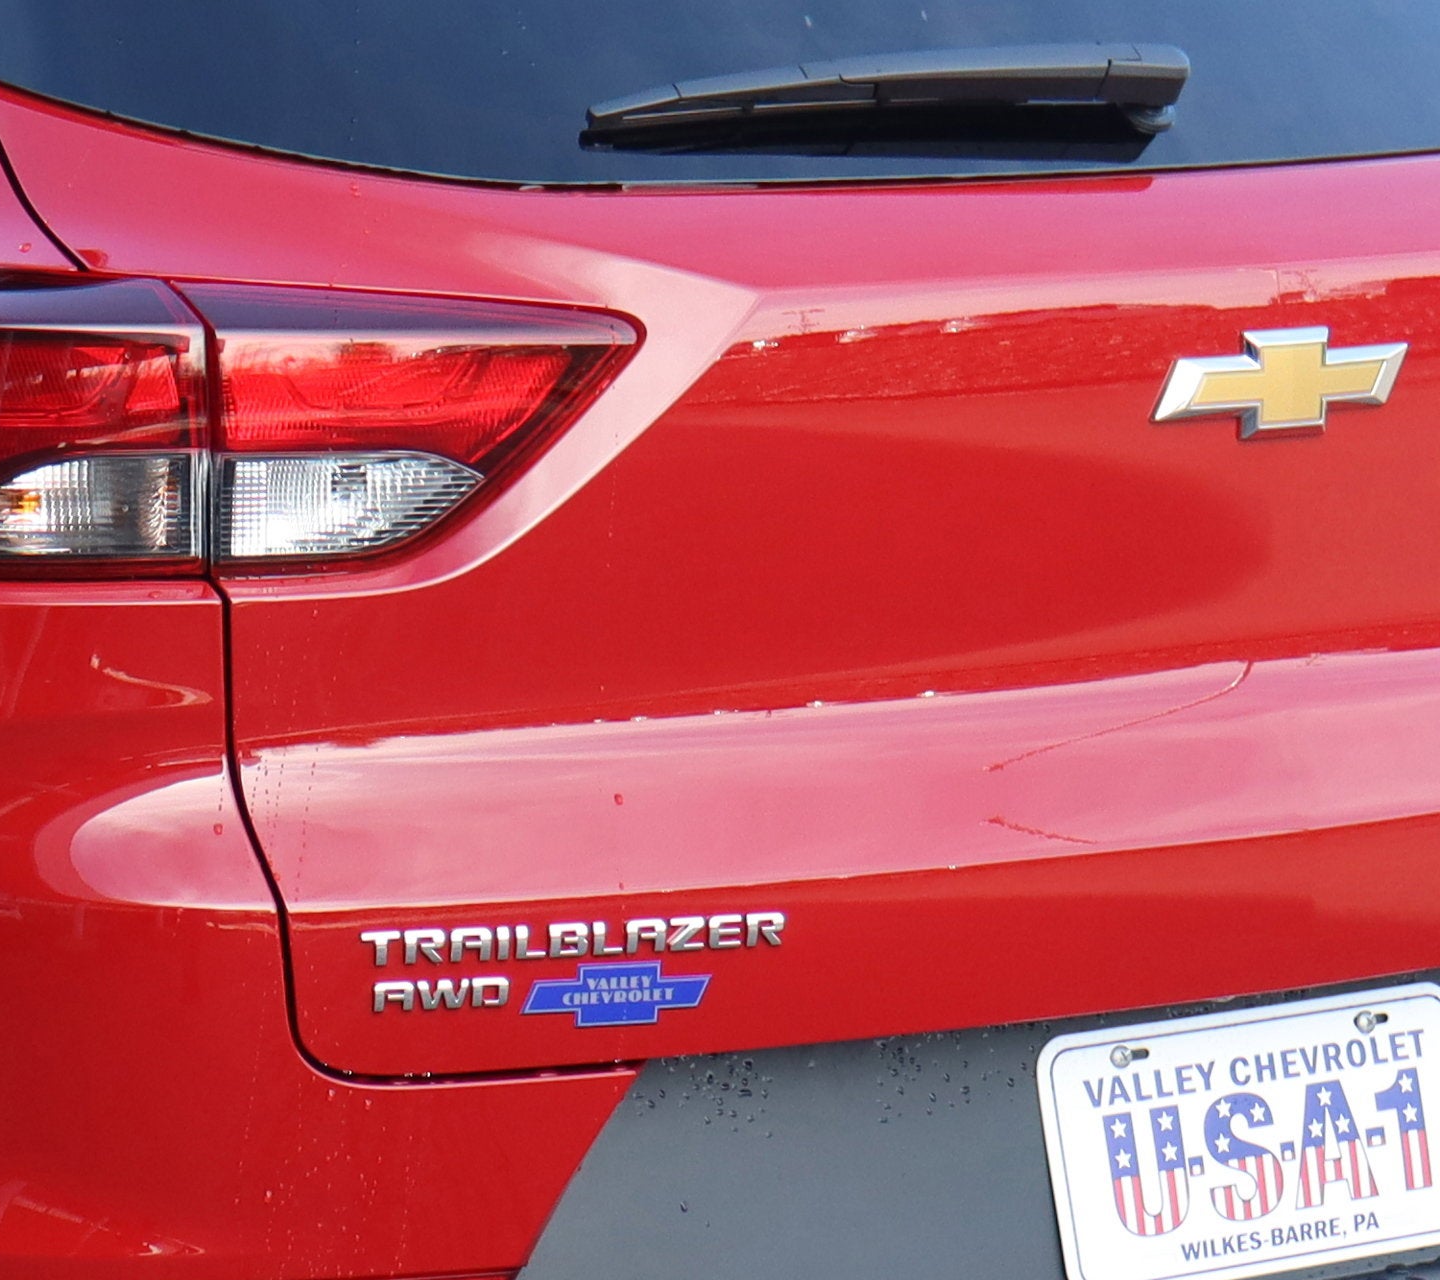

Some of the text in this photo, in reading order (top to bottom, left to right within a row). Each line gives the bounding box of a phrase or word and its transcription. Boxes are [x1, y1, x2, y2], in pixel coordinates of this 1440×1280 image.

[361, 911, 786, 967] TRAILBLAZER
[373, 974, 511, 1013] AWD
[562, 986, 675, 1007] CHEVROLET
[584, 975, 654, 991] VALLEY
[1083, 1028, 1426, 1108] VALLEY CHEVROLET
[1180, 1211, 1380, 1262] WILKES-BARRE, PA
